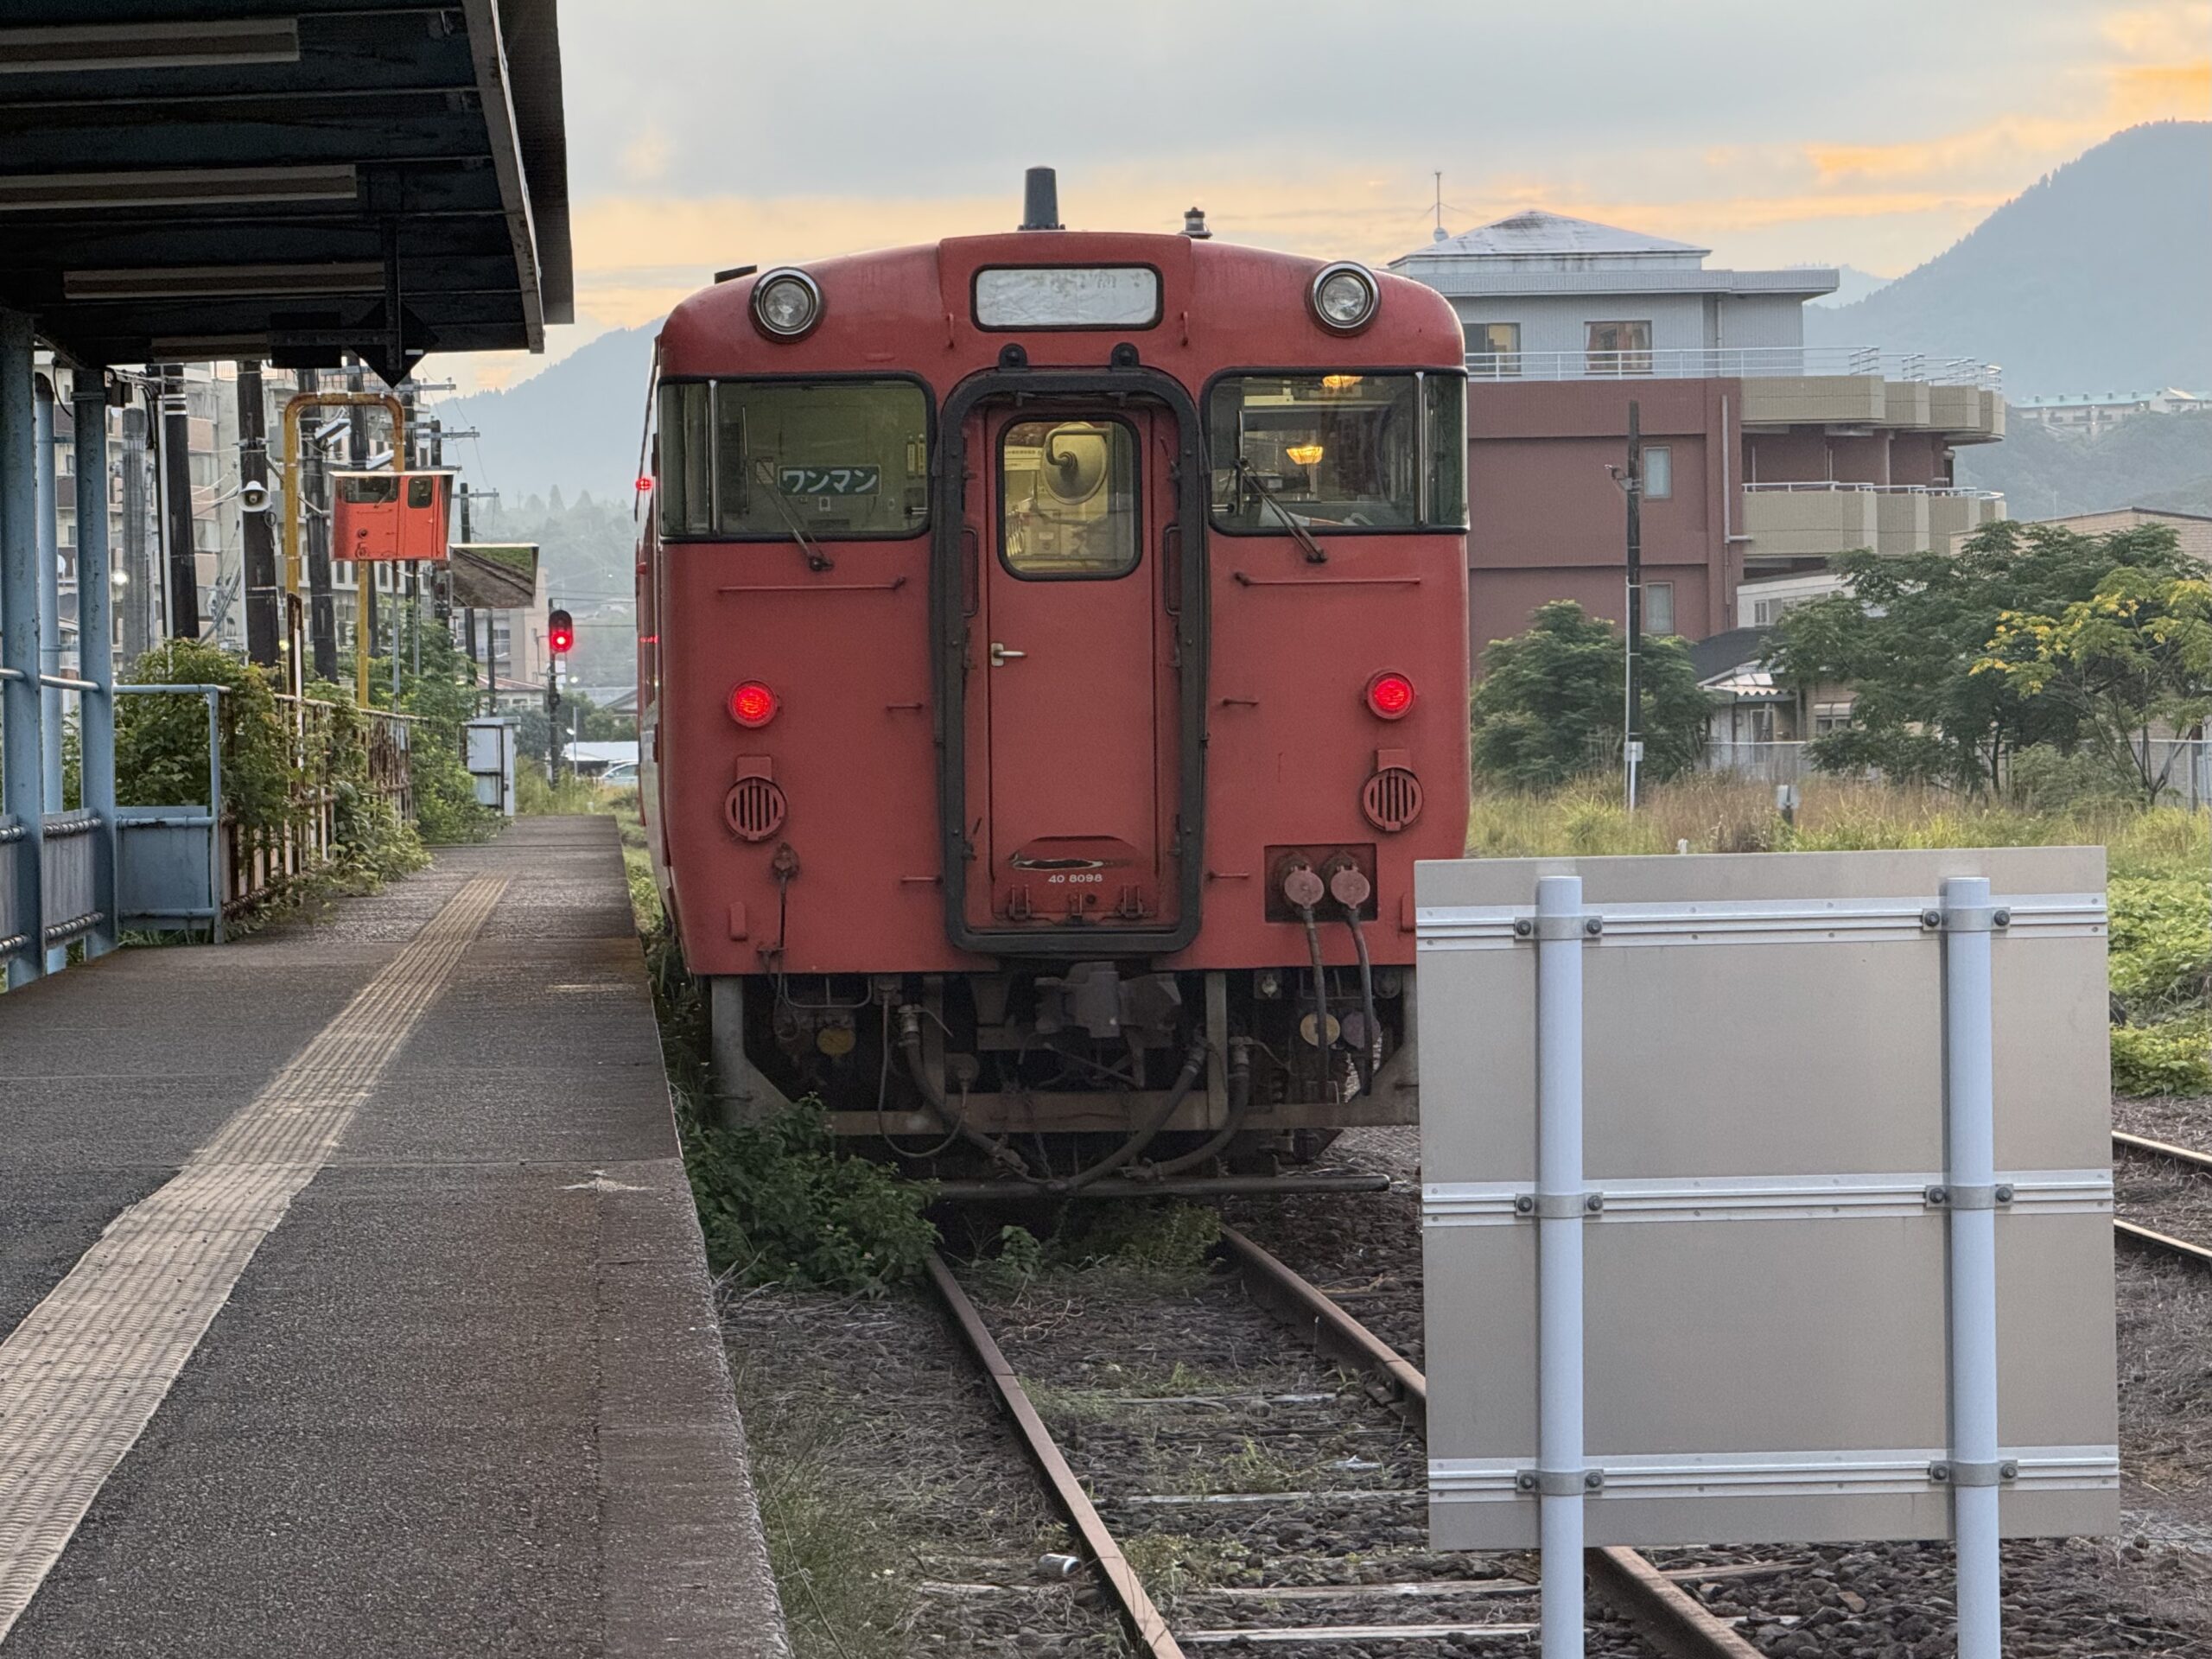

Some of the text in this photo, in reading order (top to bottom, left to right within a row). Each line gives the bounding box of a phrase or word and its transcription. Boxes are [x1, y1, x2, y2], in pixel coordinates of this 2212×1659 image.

[783, 469, 877, 493] ワンマン
[1048, 874, 1065, 883] 40
